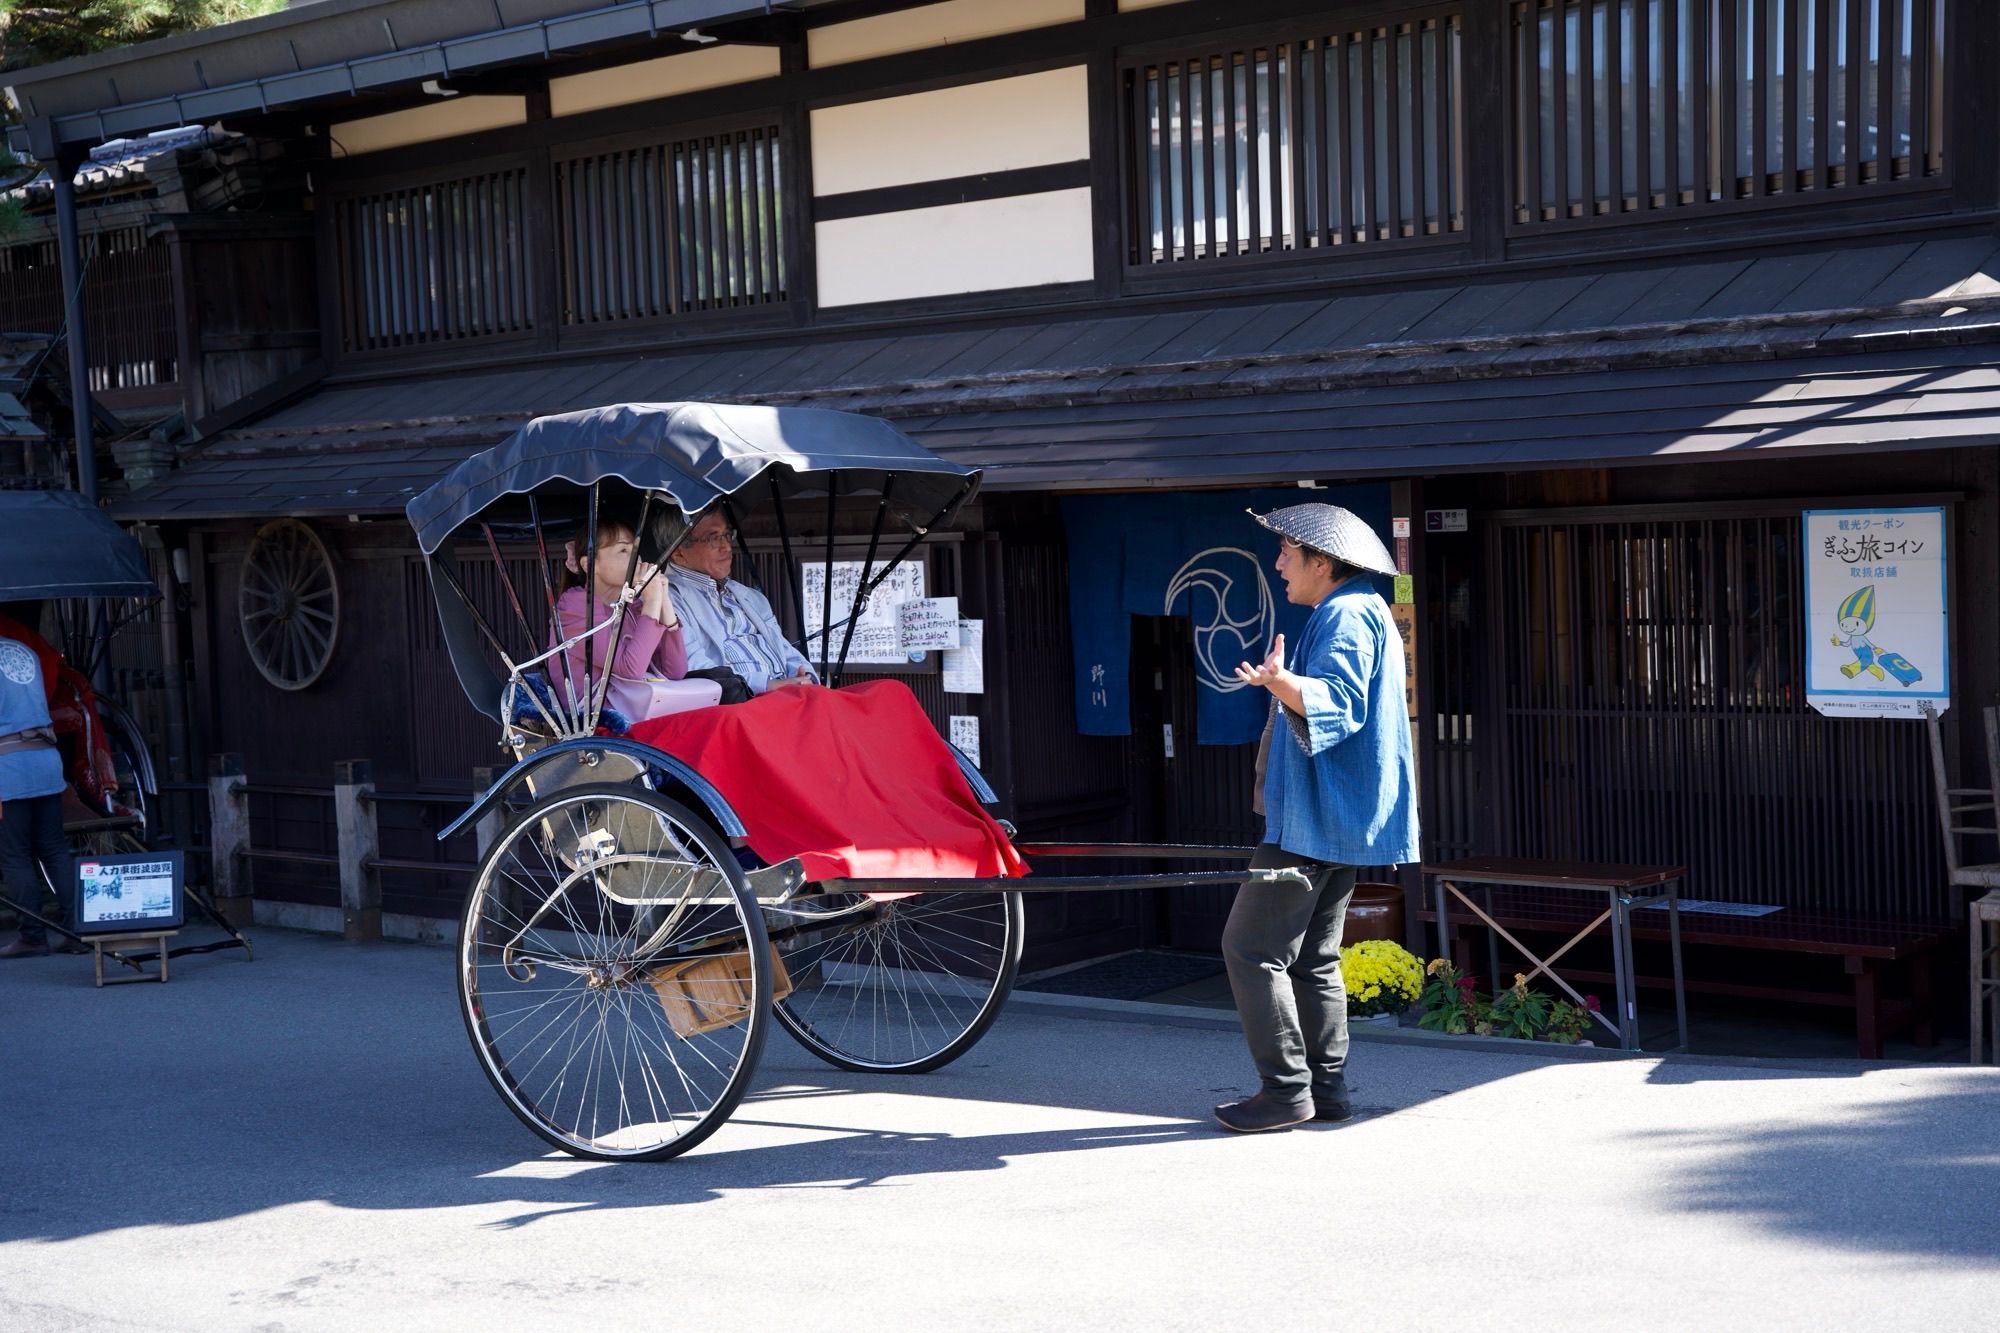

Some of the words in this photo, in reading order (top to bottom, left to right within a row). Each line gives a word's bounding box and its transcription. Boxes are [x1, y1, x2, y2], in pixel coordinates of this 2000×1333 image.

[1838, 517, 1904, 530] 観光クーポン
[1824, 534, 1923, 563] ぎふ旅コイン
[911, 563, 921, 597] うどん
[1850, 566, 1897, 578] 取扱店舗
[1090, 664, 1107, 707] 野川
